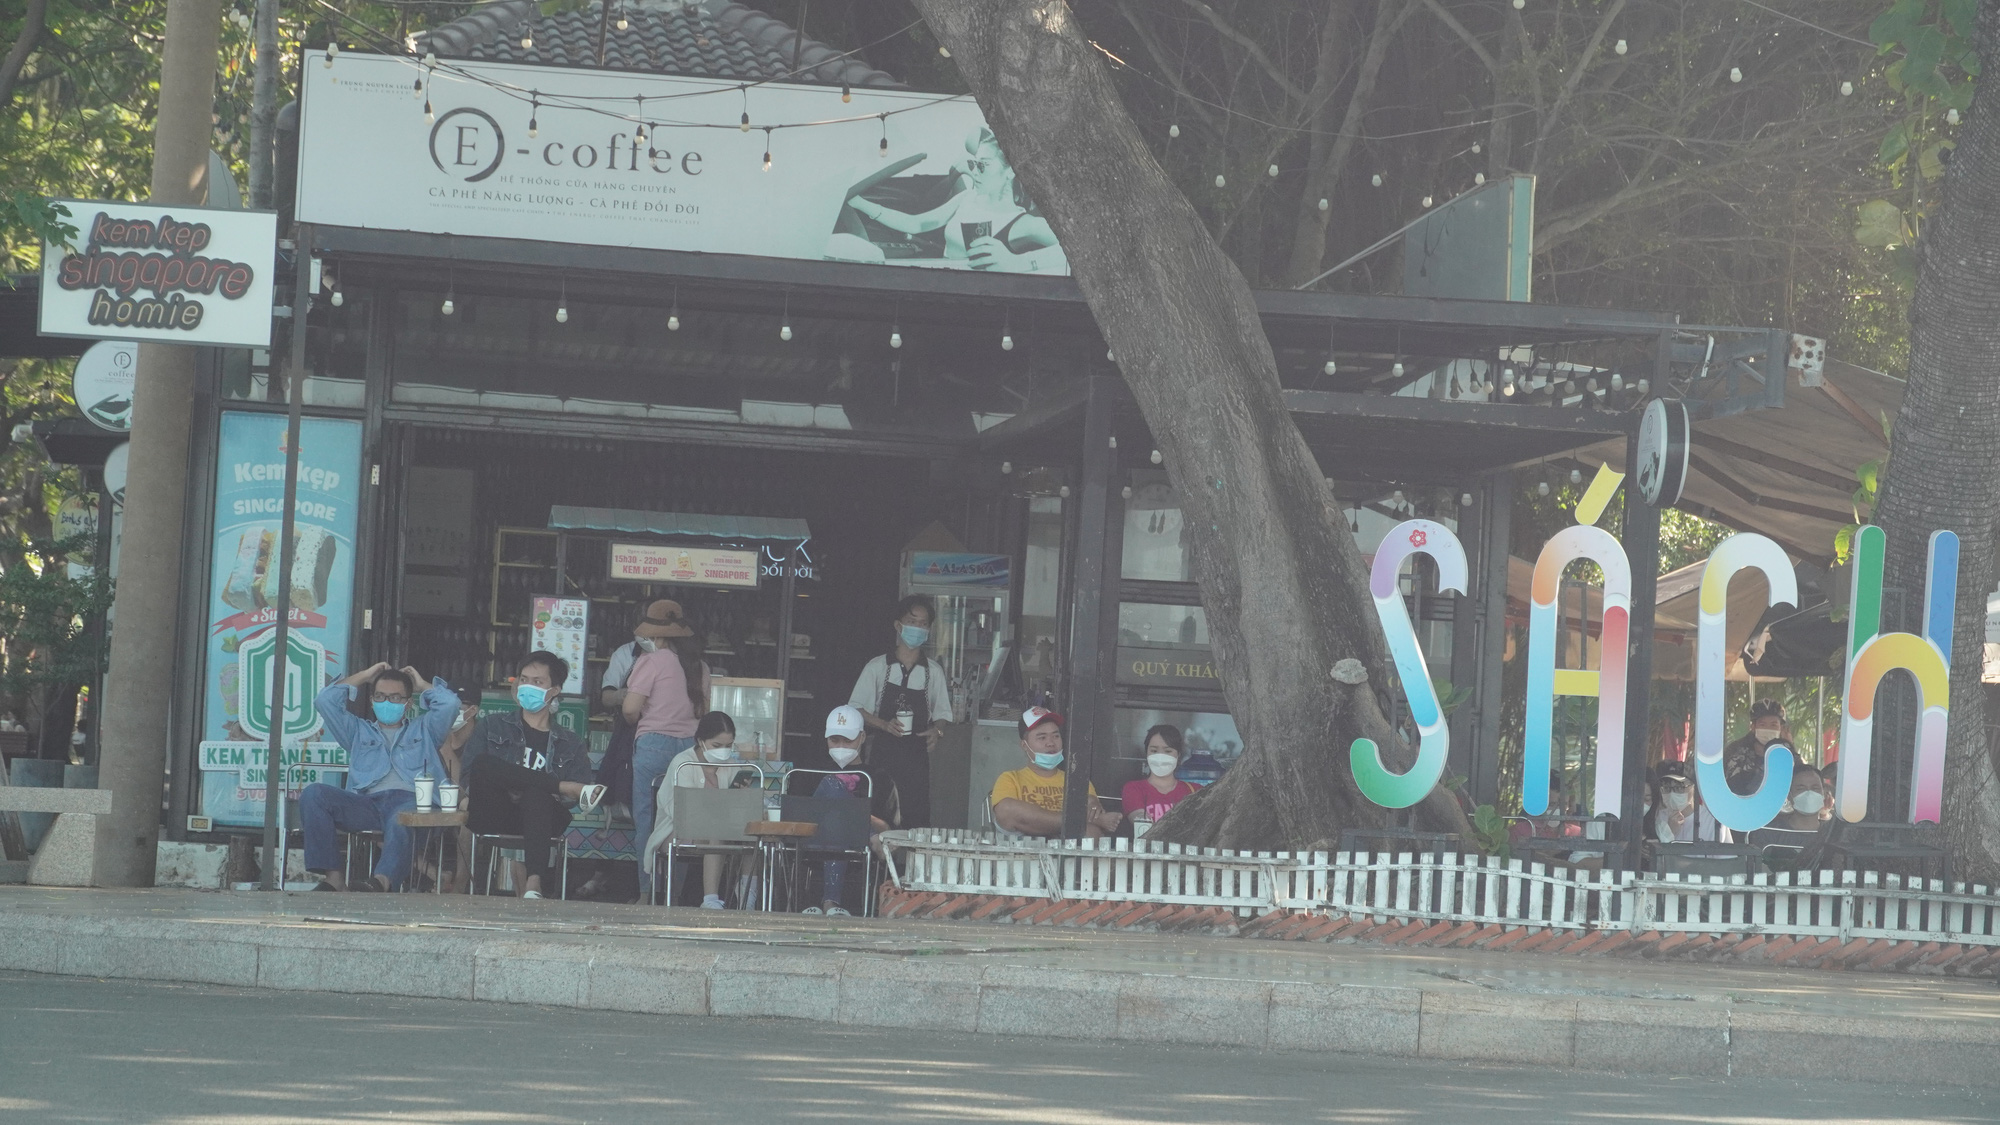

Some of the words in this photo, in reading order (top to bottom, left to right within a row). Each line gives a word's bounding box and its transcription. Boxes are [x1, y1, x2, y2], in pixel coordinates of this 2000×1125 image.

[520, 176, 561, 187] THỐNG
[565, 179, 588, 189] CỬA
[594, 181, 626, 191] HÀNG
[631, 184, 677, 194] CHUYÊN
[428, 186, 446, 198] CÀ
[452, 188, 478, 200] PHÊ
[528, 193, 574, 206] LƯỢNG
[589, 197, 607, 208] CÀ
[613, 199, 638, 210] PHÊ
[675, 203, 700, 215] ĐỜI
[94, 215, 150, 243] kem
[63, 248, 248, 294] singapore
[93, 293, 200, 326] homie
[234, 462, 286, 483] Kem
[297, 460, 340, 491] kẹp
[615, 555, 637, 564] 15h30
[644, 556, 667, 565] 22h00
[941, 563, 995, 575] ALASKA
[622, 565, 641, 574] KEM
[704, 569, 750, 580] SINGAPORE
[1132, 659, 1171, 677] QUÝ
[1175, 661, 1221, 678] KHÁ
[206, 747, 245, 765] KEM
[246, 769, 286, 783] SINE
